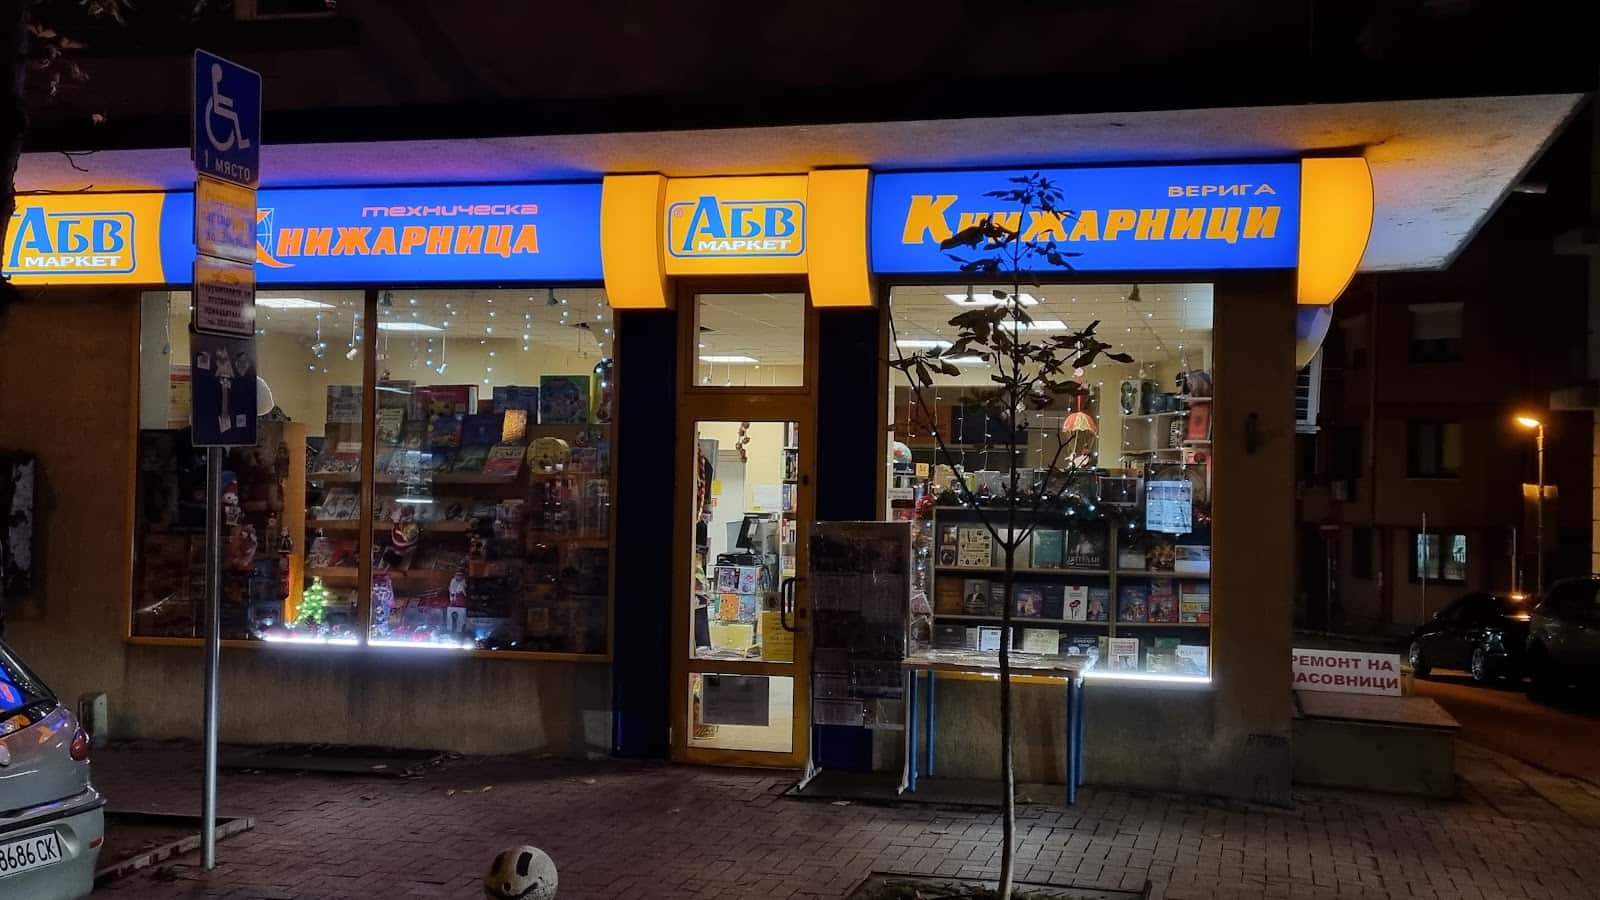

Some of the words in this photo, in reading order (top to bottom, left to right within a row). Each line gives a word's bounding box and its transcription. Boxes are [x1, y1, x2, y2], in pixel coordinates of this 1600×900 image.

[215, 157, 250, 181] МЯСТО
[1167, 183, 1276, 198] ВЕРИГА
[682, 194, 796, 251] АБВ
[8, 206, 126, 268] АБВ
[697, 239, 792, 251] МАРКЕТ
[24, 256, 121, 268] МАРКЕТ
[1367, 659, 1394, 672] НА
[1293, 672, 1398, 690] АСОВНИЦИ
